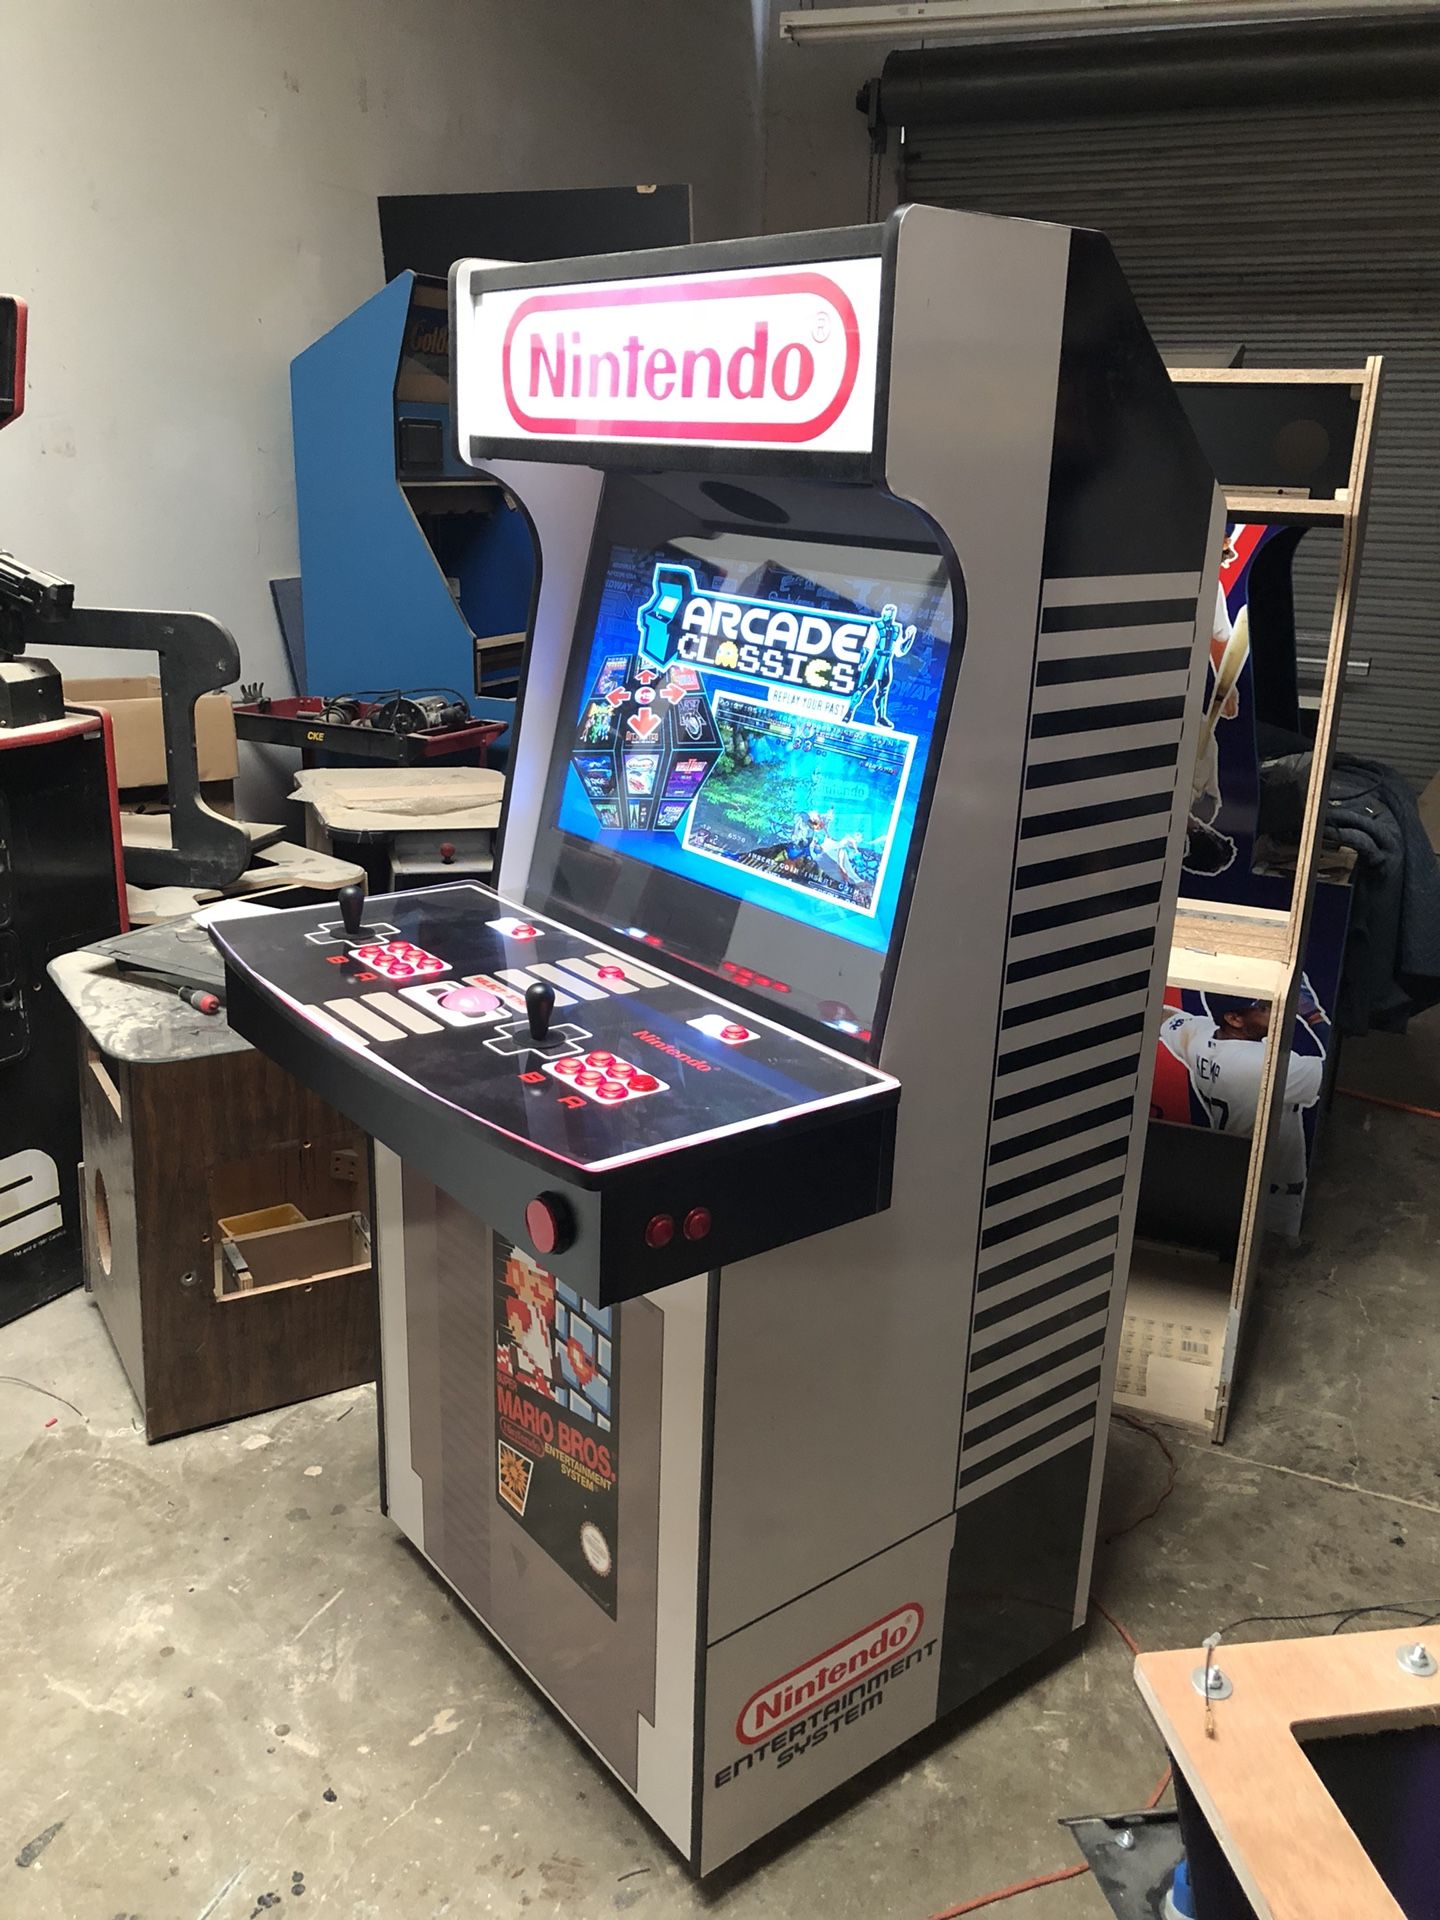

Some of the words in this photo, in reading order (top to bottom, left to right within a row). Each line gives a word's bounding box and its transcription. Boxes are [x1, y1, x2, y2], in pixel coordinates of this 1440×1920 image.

[681, 597, 869, 664] ARCADE
[773, 689, 800, 706] REPLAY
[803, 696, 824, 711] YOUR
[826, 700, 845, 717] PAST
[307, 731, 325, 742] CKE
[326, 955, 350, 965] B
[353, 971, 379, 982] A
[632, 1029, 712, 1073] Nintendo
[517, 1071, 547, 1084] B
[557, 1095, 588, 1109] A
[496, 1385, 554, 1443] MARIO
[557, 1420, 617, 1483] BROS.
[544, 1442, 612, 1491] ENTERTAINMENT
[560, 1463, 595, 1492] SYSTEM
[715, 1638, 938, 1789] ENTERTAINMENT
[776, 1690, 883, 1769] SYSTEM
